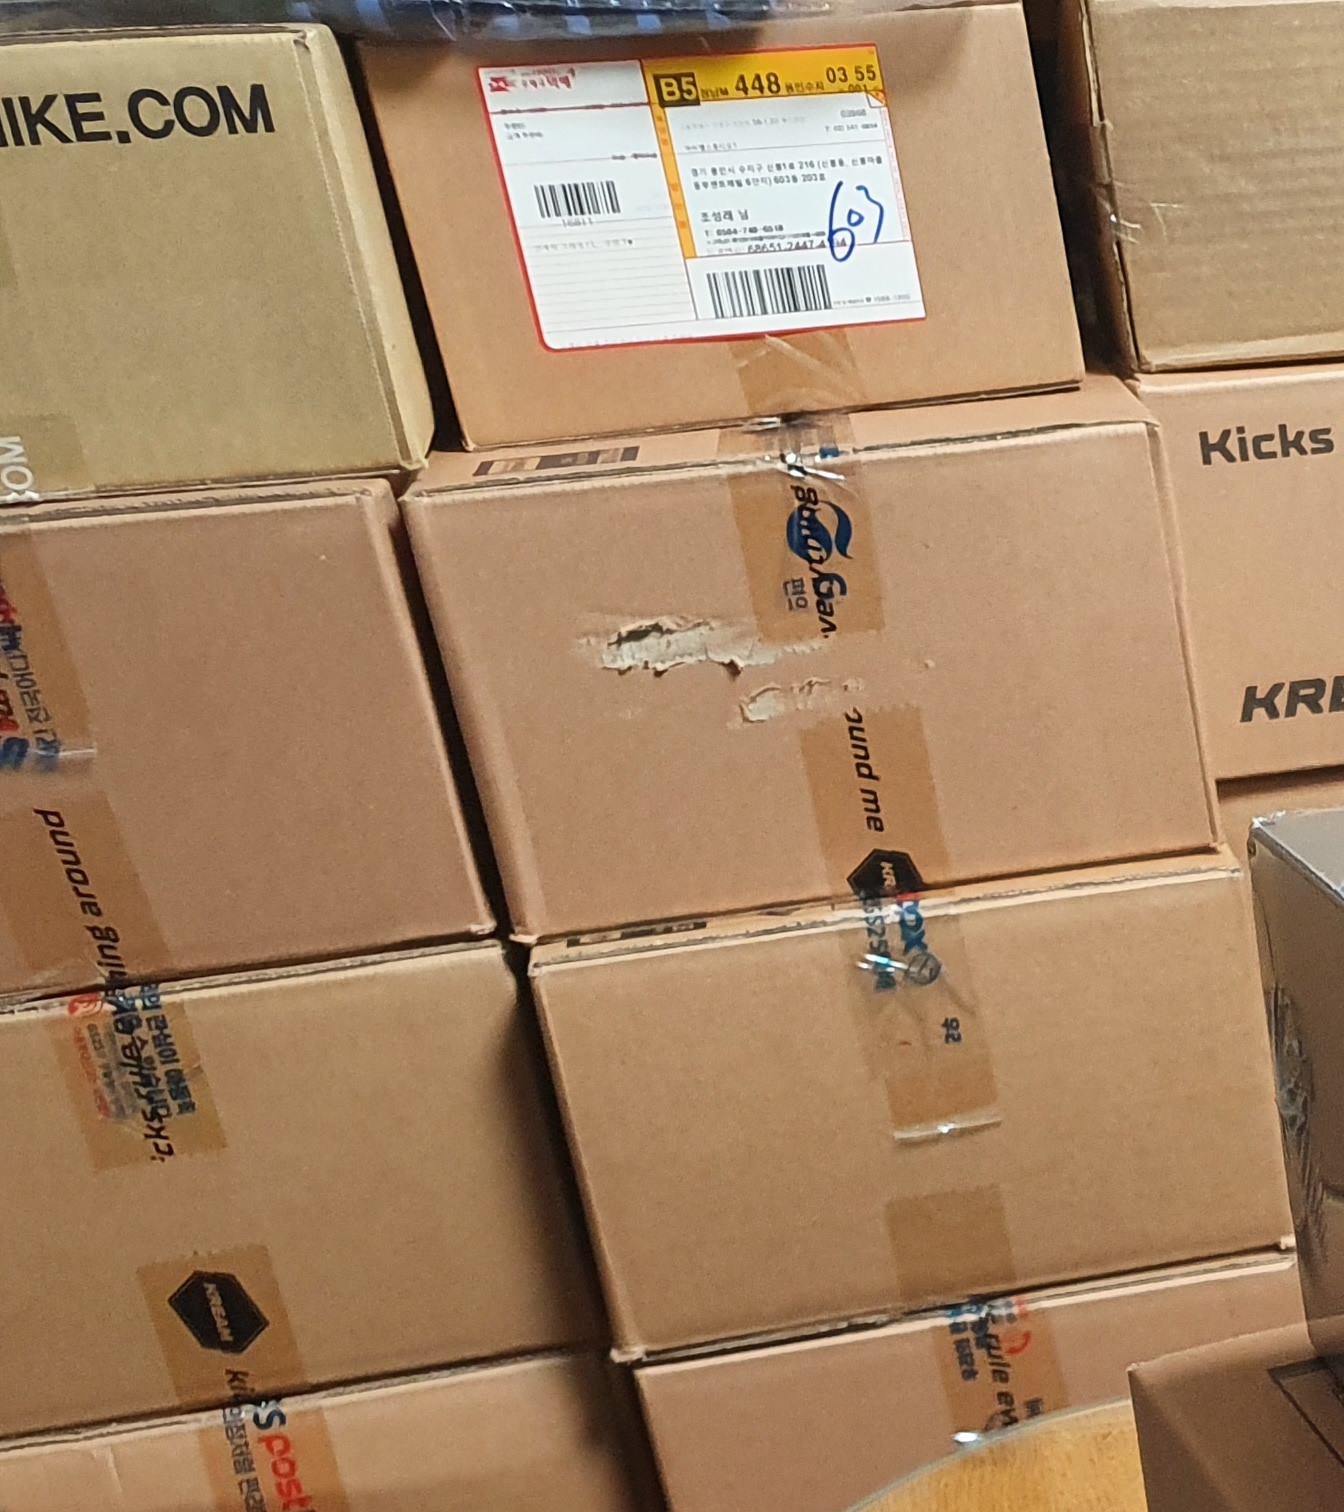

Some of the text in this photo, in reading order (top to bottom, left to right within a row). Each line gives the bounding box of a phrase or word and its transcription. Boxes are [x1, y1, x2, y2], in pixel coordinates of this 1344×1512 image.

[659, 75, 698, 101] B5
[734, 71, 782, 96] 448
[825, 63, 878, 84] 03 55
[1199, 423, 1335, 466] Kicks
[860, 787, 885, 833] me
[34, 808, 104, 918] around
